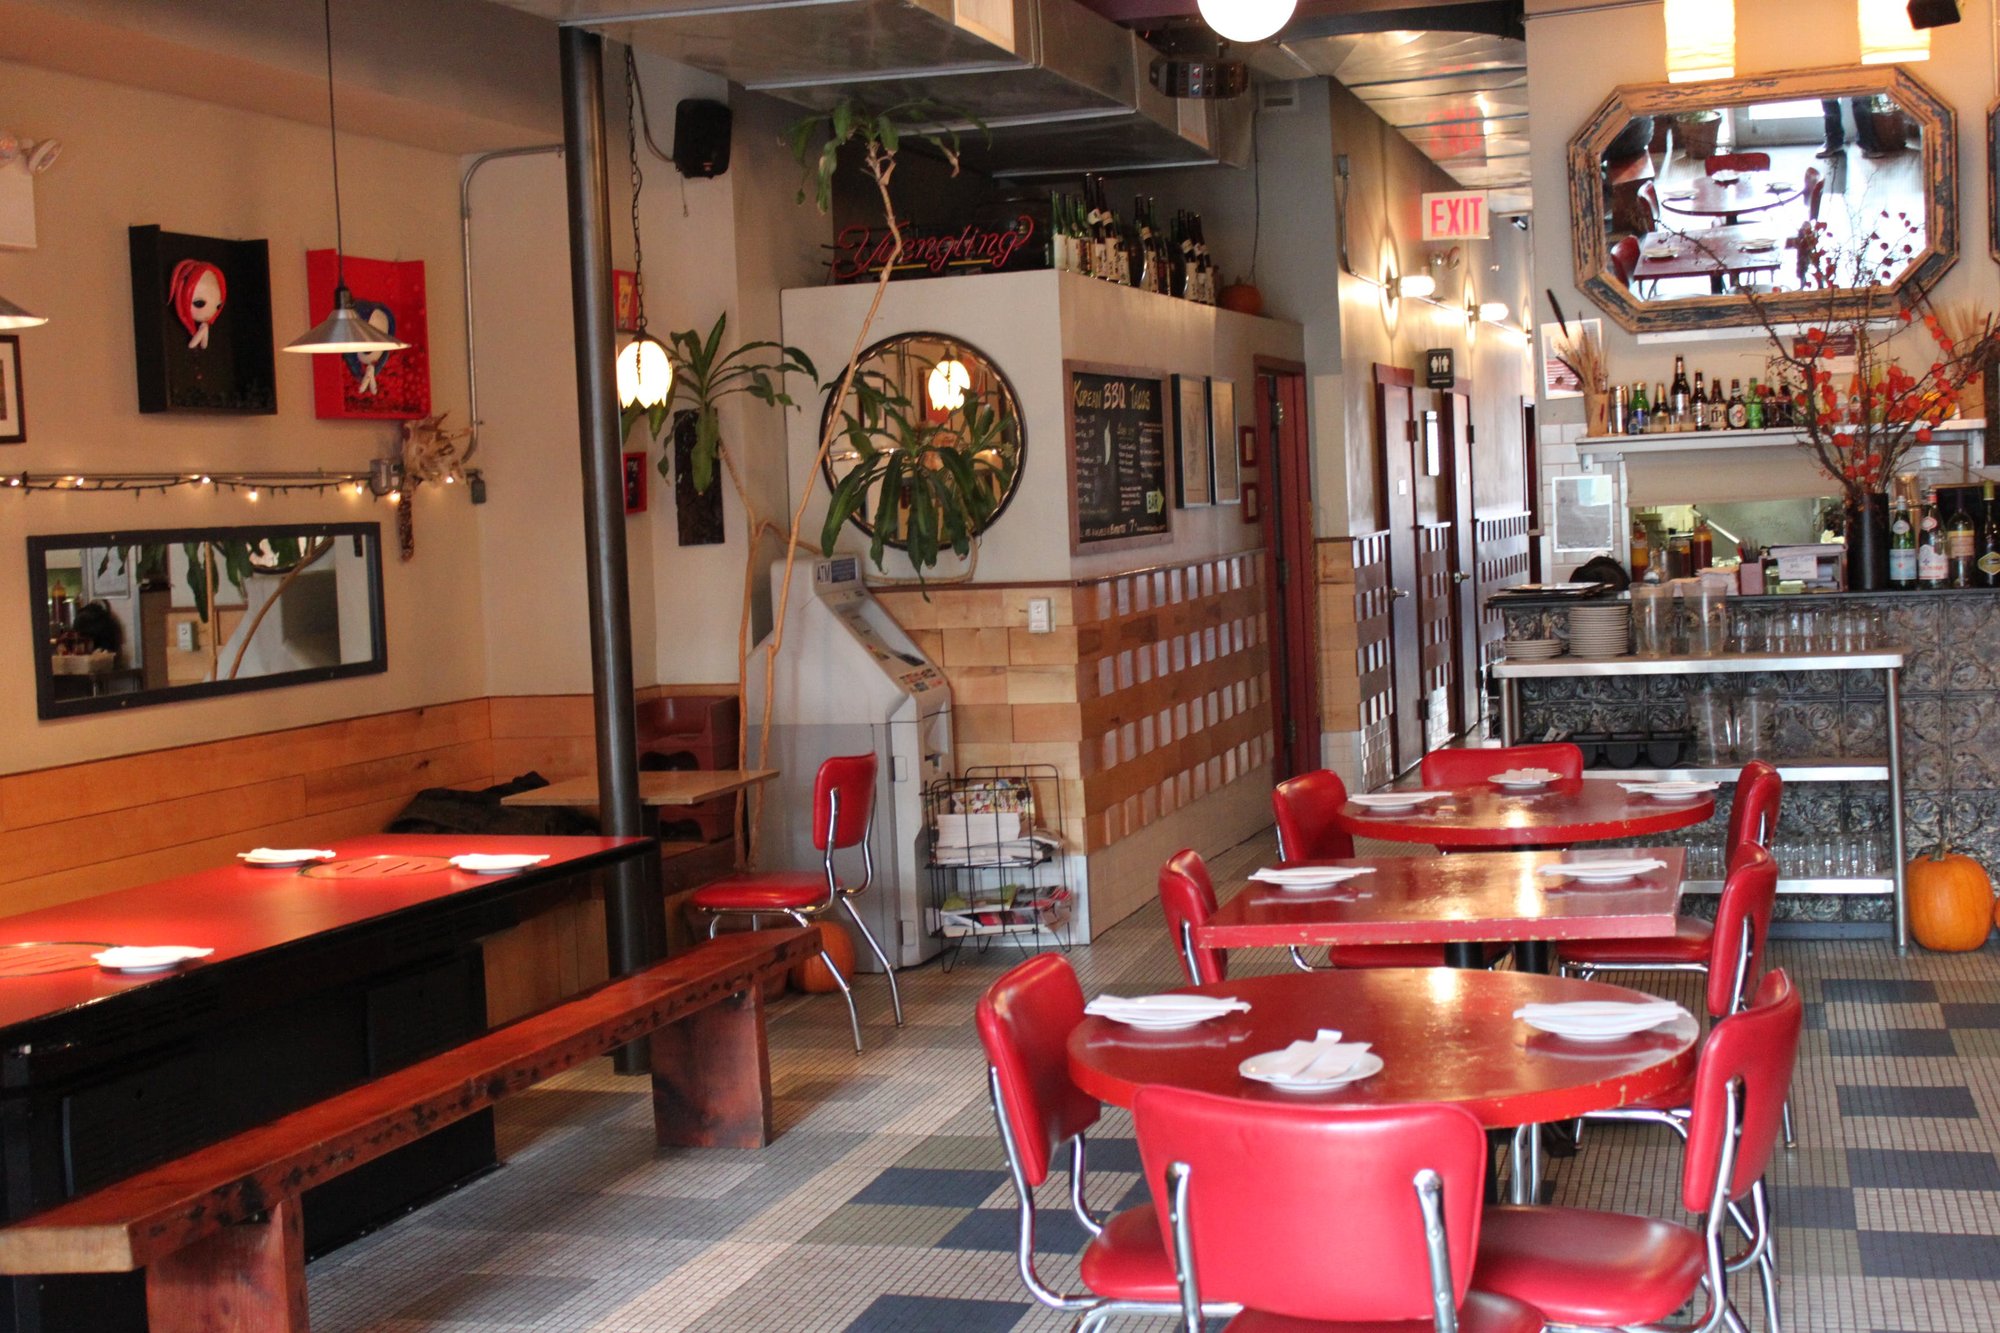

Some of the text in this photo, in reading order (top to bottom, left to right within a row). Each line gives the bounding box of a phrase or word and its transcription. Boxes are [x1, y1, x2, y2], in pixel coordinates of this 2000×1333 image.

[1431, 196, 1483, 237] EXIT
[1103, 381, 1127, 411] BBQ
[1129, 383, 1151, 411] TACOS
[1147, 493, 1159, 510] BAR
[816, 564, 831, 583] ATM
